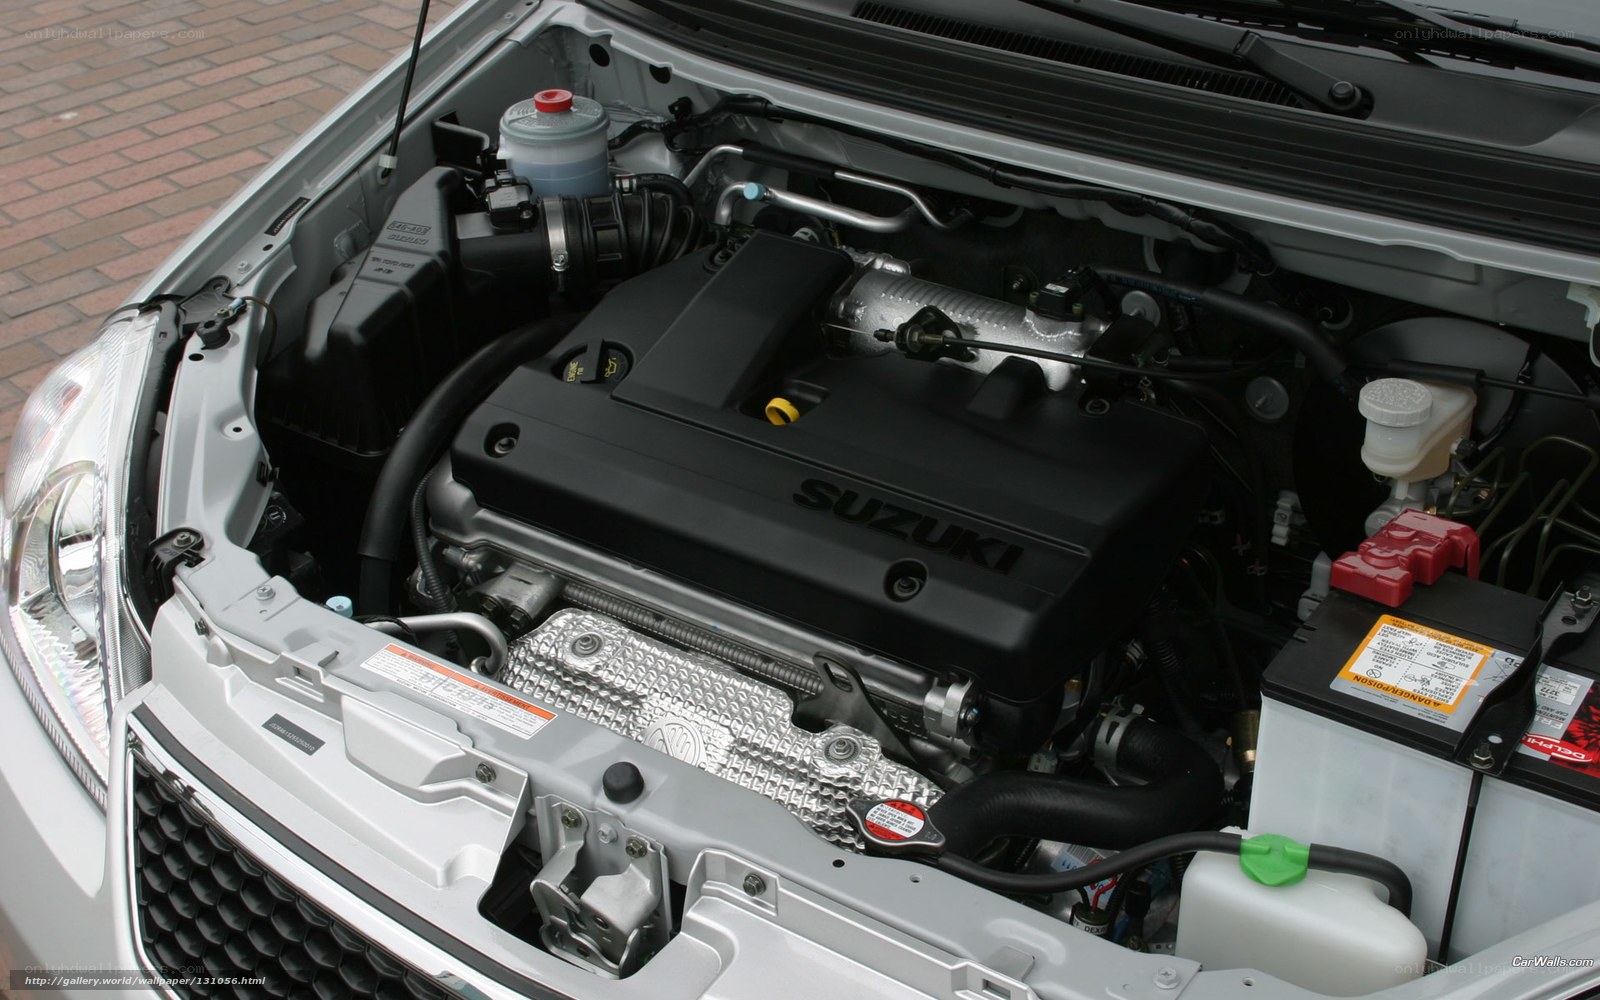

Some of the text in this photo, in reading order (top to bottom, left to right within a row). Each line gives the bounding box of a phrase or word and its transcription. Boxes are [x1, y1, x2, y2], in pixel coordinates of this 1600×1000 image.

[567, 361, 578, 382] ENGINE
[792, 478, 1025, 576] SUZUKI
[1425, 651, 1469, 668] SULFURIC ACID
[1352, 675, 1433, 703] DANGER/POISON
[1411, 688, 1450, 703] SHIELD EYES
[1419, 686, 1452, 700] EXPLOSIVE
[1527, 738, 1586, 760] DELPHI
